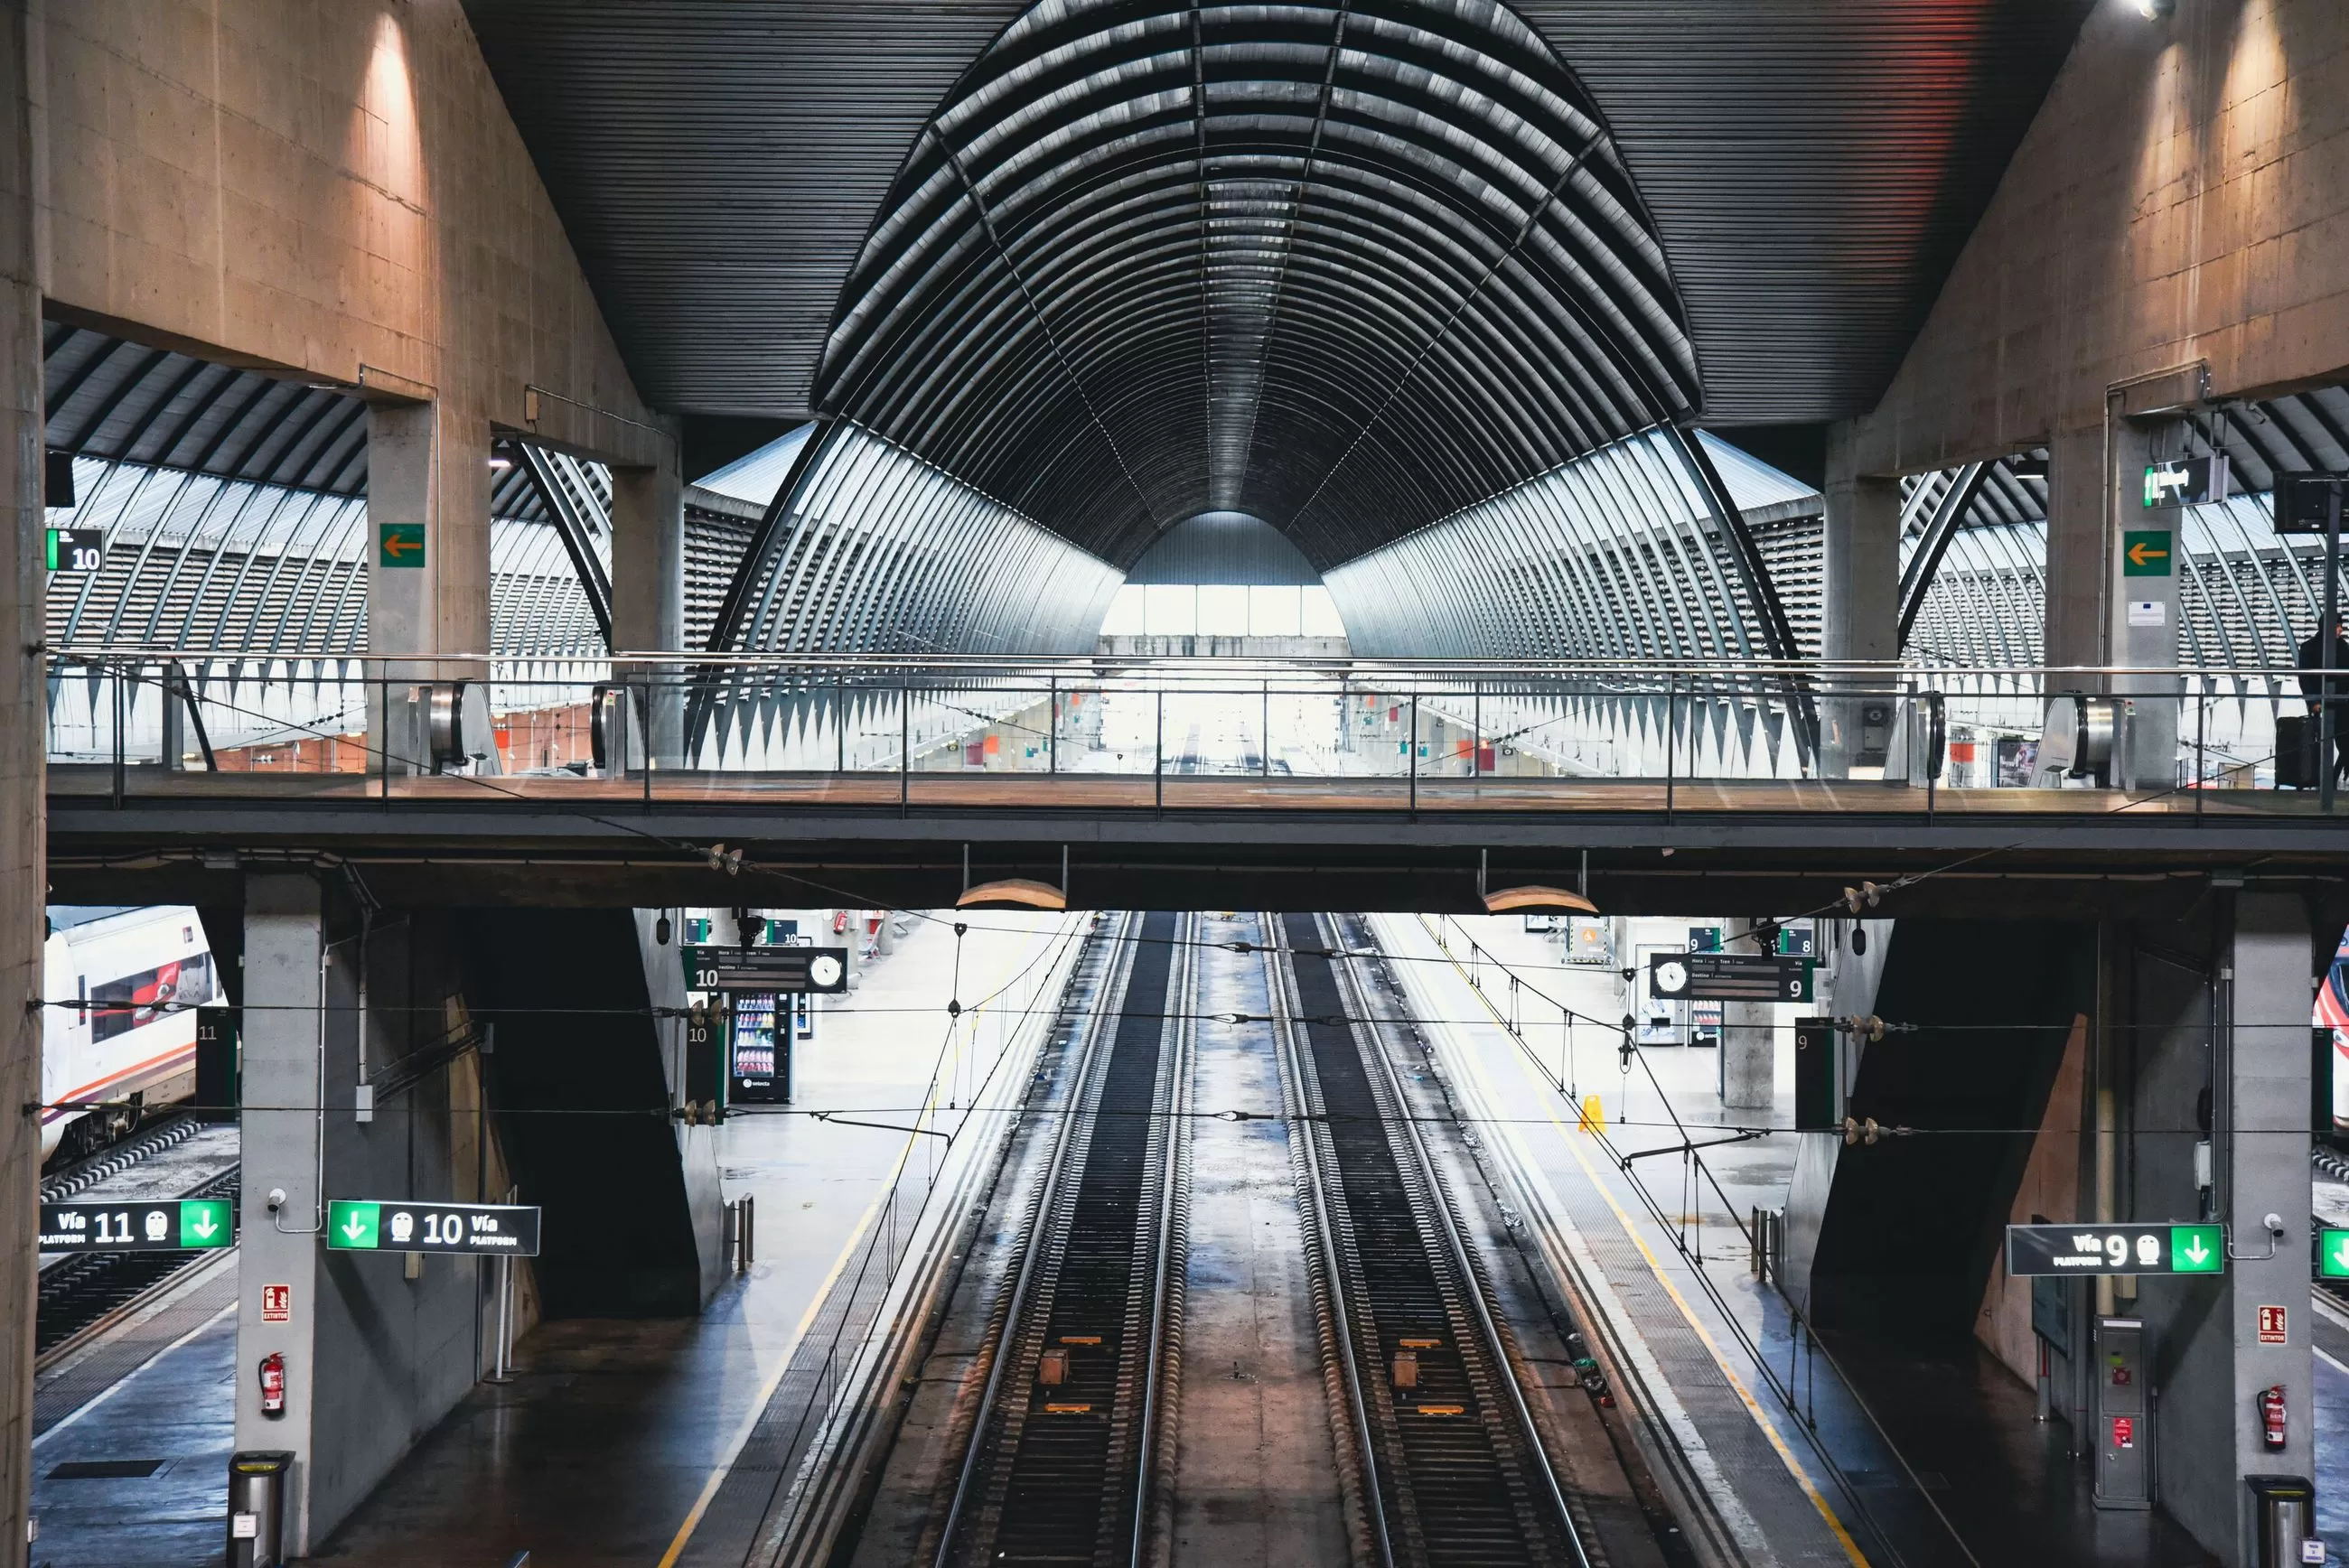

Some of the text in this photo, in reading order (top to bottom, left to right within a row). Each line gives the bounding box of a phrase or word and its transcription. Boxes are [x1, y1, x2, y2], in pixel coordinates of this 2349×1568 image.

[72, 548, 100, 570] 10
[784, 934, 797, 944] 10
[1690, 938, 1699, 951] 9
[1802, 940, 1811, 952] 8
[696, 969, 718, 987] 10
[1789, 980, 1802, 998] 9
[199, 1025, 217, 1041] 11
[688, 1028, 707, 1042] 10
[1798, 1035, 1808, 1050] 9
[58, 1211, 86, 1230] Vía
[94, 1212, 135, 1243] 11
[423, 1213, 463, 1245] 10
[471, 1214, 498, 1232] Vía
[39, 1235, 86, 1245] PLATFORM
[470, 1236, 518, 1246] PLATFORM
[2073, 1234, 2101, 1253] Vía
[2105, 1235, 2128, 1266] 9
[2260, 1334, 2285, 1342] EXTINTOR
